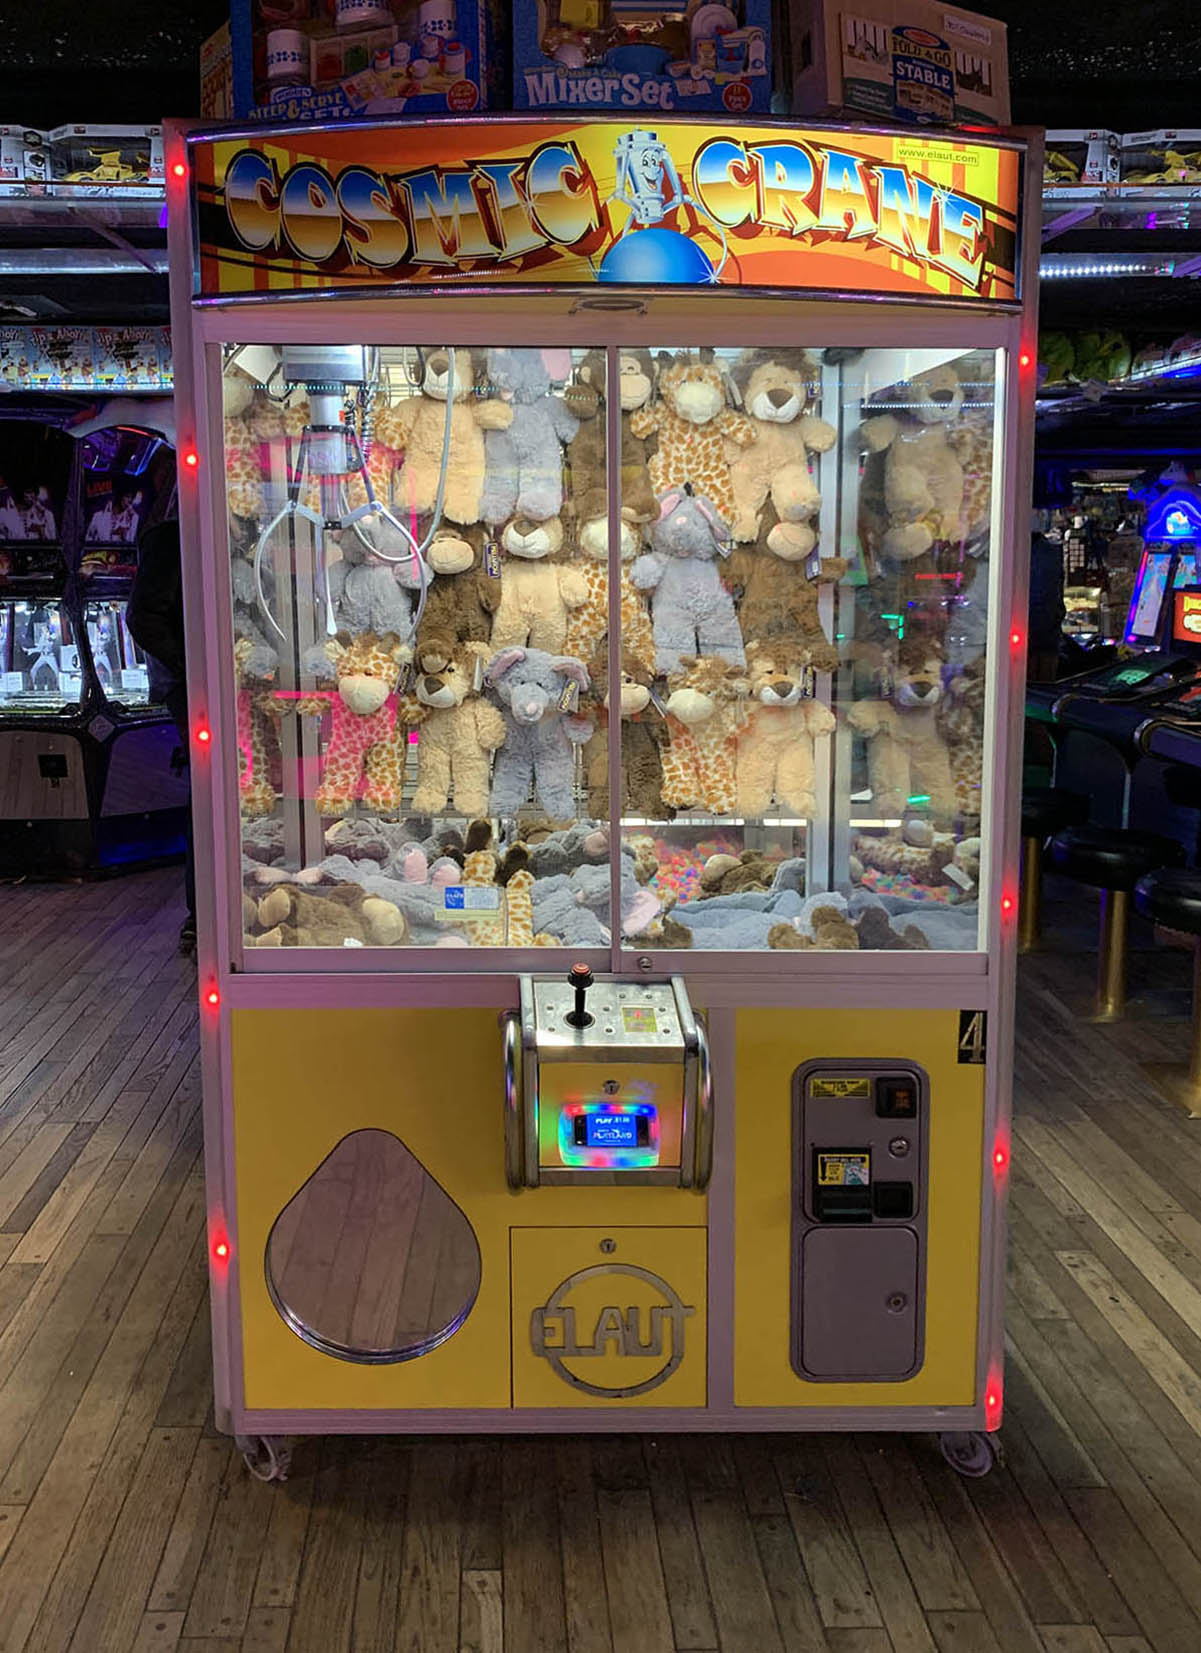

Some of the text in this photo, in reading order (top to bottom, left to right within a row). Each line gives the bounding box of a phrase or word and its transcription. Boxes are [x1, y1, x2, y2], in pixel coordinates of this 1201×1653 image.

[896, 60, 951, 89] STABLE
[935, 51, 951, 67] GO
[621, 72, 675, 110] Set
[898, 147, 978, 164] www.elaut.com
[225, 136, 988, 291] COSMIC CRANE
[959, 1011, 985, 1063] 4
[530, 1305, 696, 1357] ELAUT
